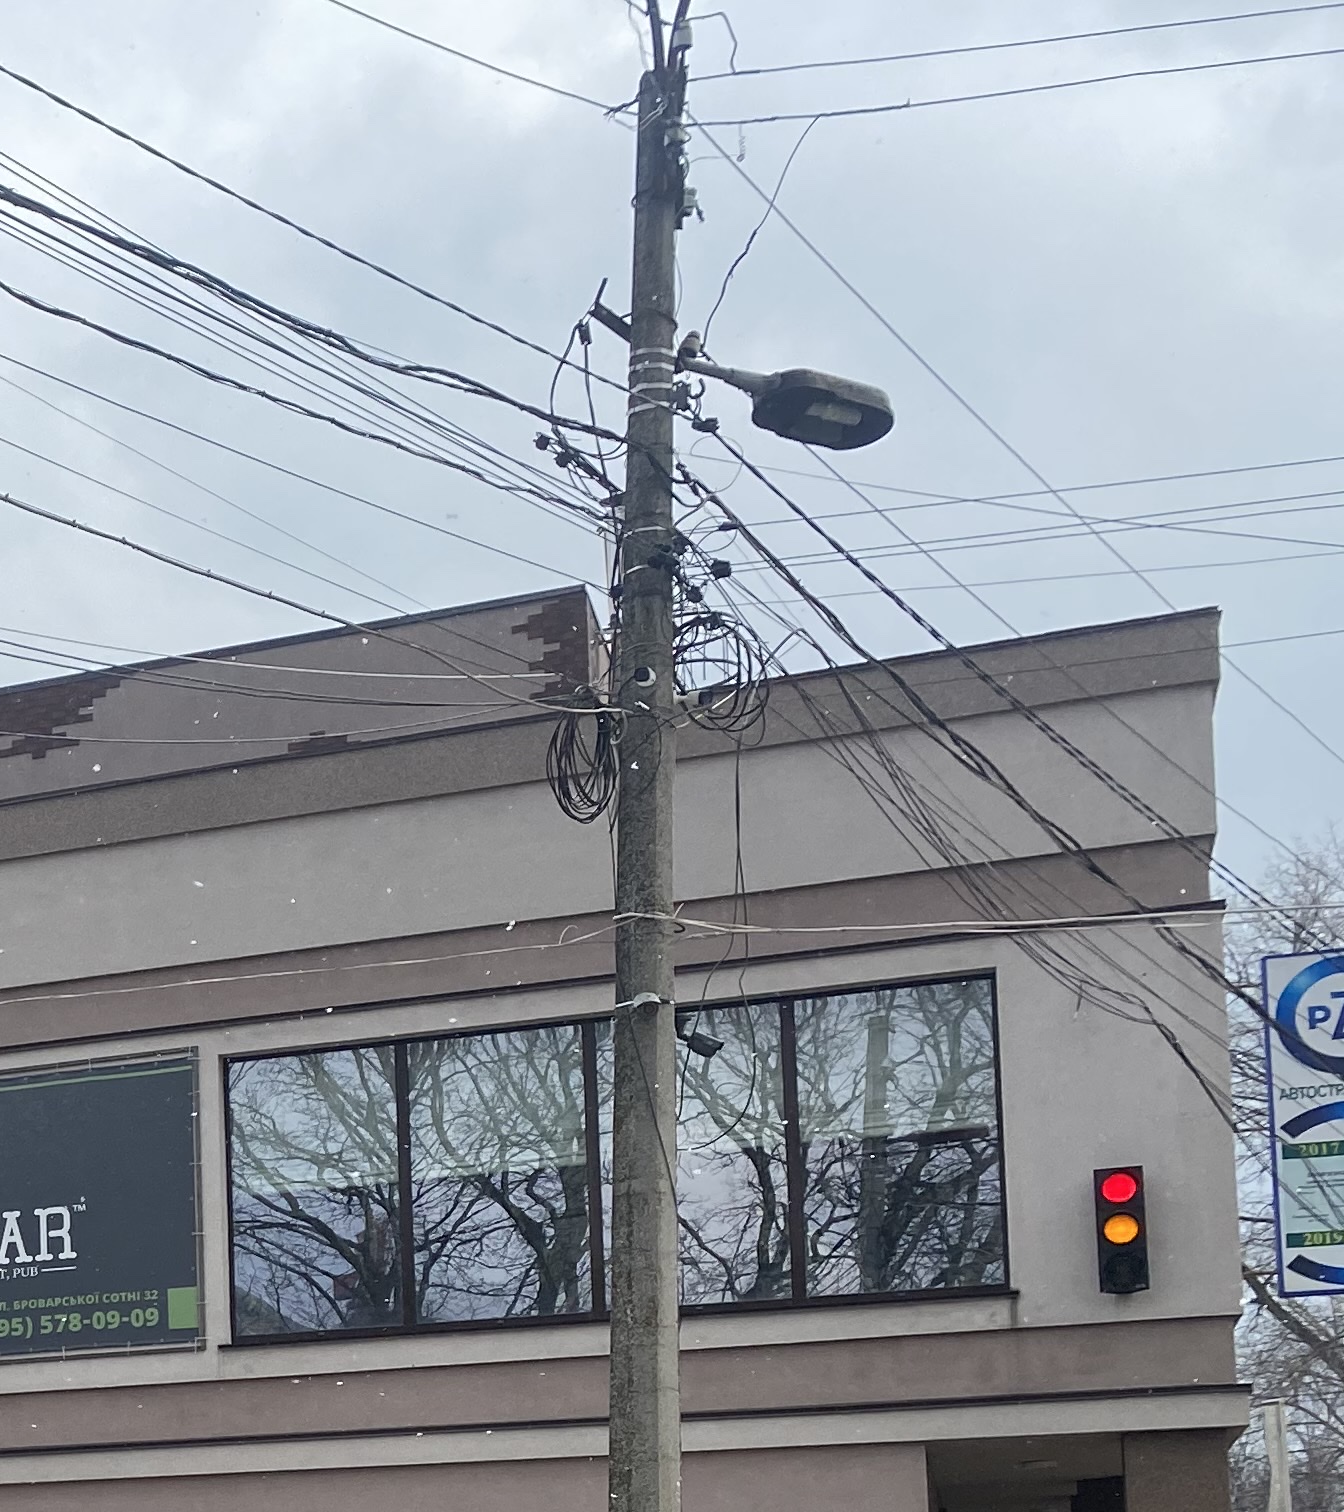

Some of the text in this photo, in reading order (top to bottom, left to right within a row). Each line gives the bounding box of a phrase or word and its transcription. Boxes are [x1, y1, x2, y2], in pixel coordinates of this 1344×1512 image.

[1299, 1142, 1340, 1156] 2017
[13, 1266, 38, 1278] PUB
[13, 1291, 99, 1311] БРОВАРСЬКОЇ
[103, 1291, 140, 1304] СОТНІ
[144, 1289, 159, 1301] 32
[40, 1307, 159, 1335] 578-09-09
